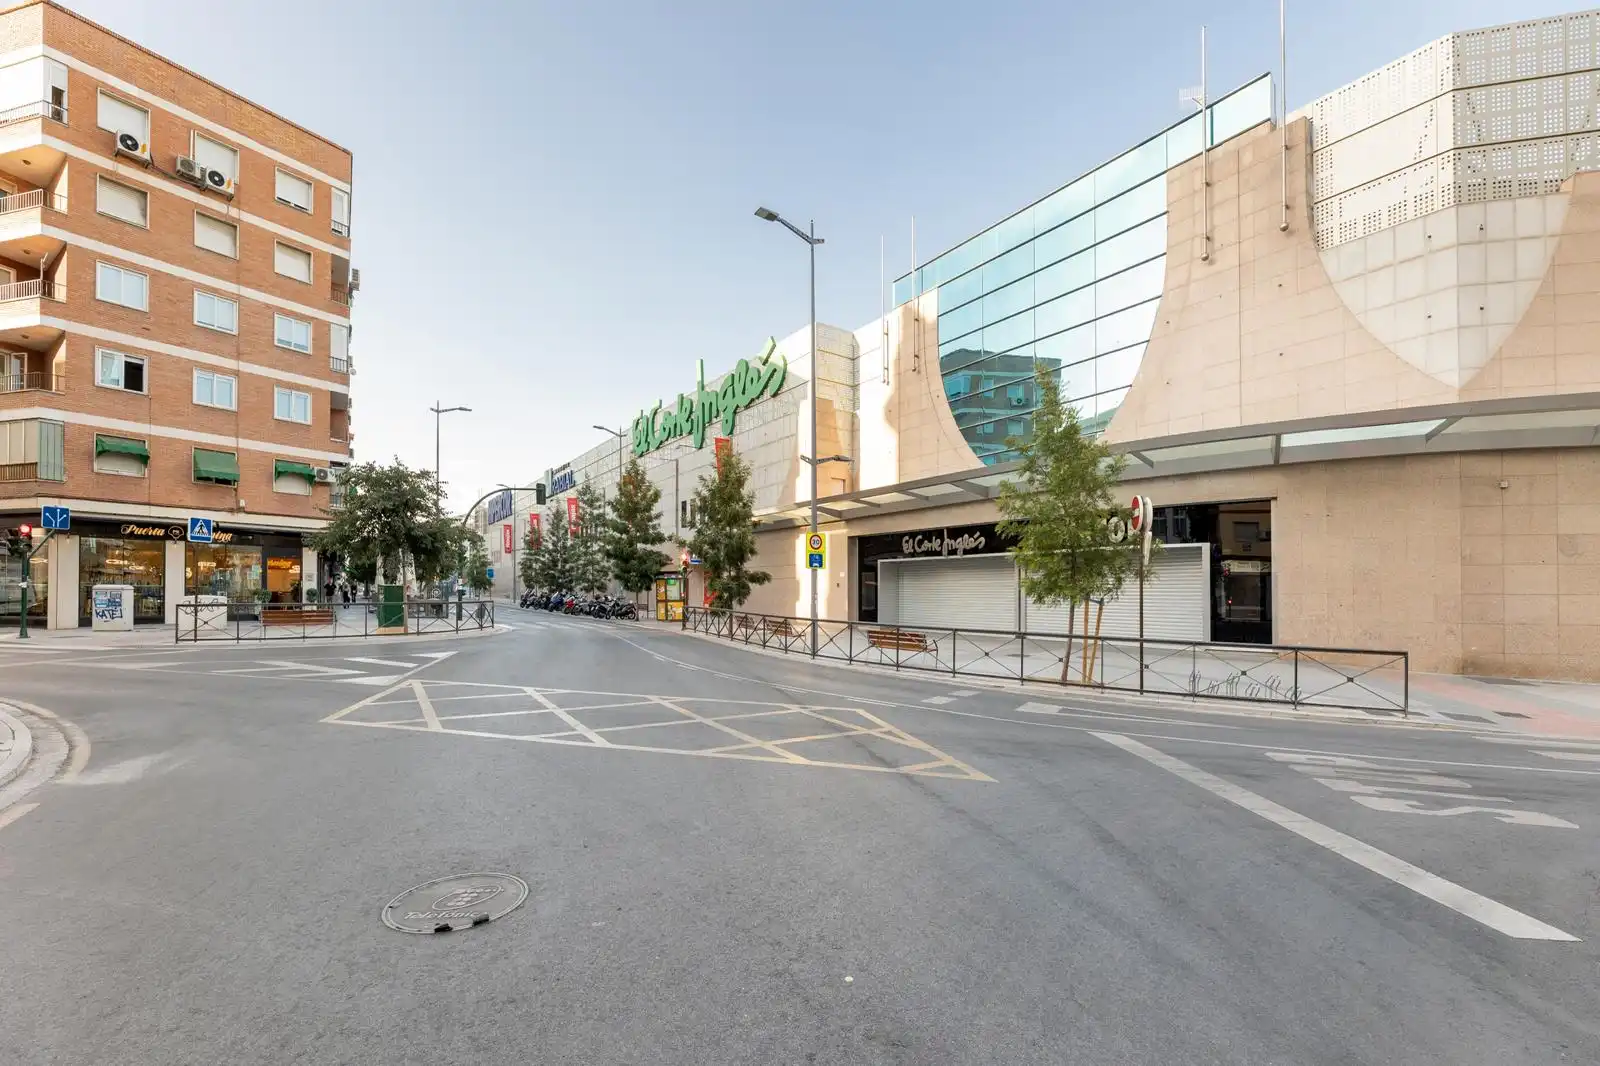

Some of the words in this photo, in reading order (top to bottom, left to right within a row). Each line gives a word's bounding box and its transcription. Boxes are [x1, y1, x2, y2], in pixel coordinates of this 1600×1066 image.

[632, 410, 650, 457] El
[650, 394, 693, 450] Corte
[120, 524, 165, 537] Puerta
[902, 535, 914, 554] El
[914, 535, 941, 553] Corte
[942, 528, 985, 557] Inglés
